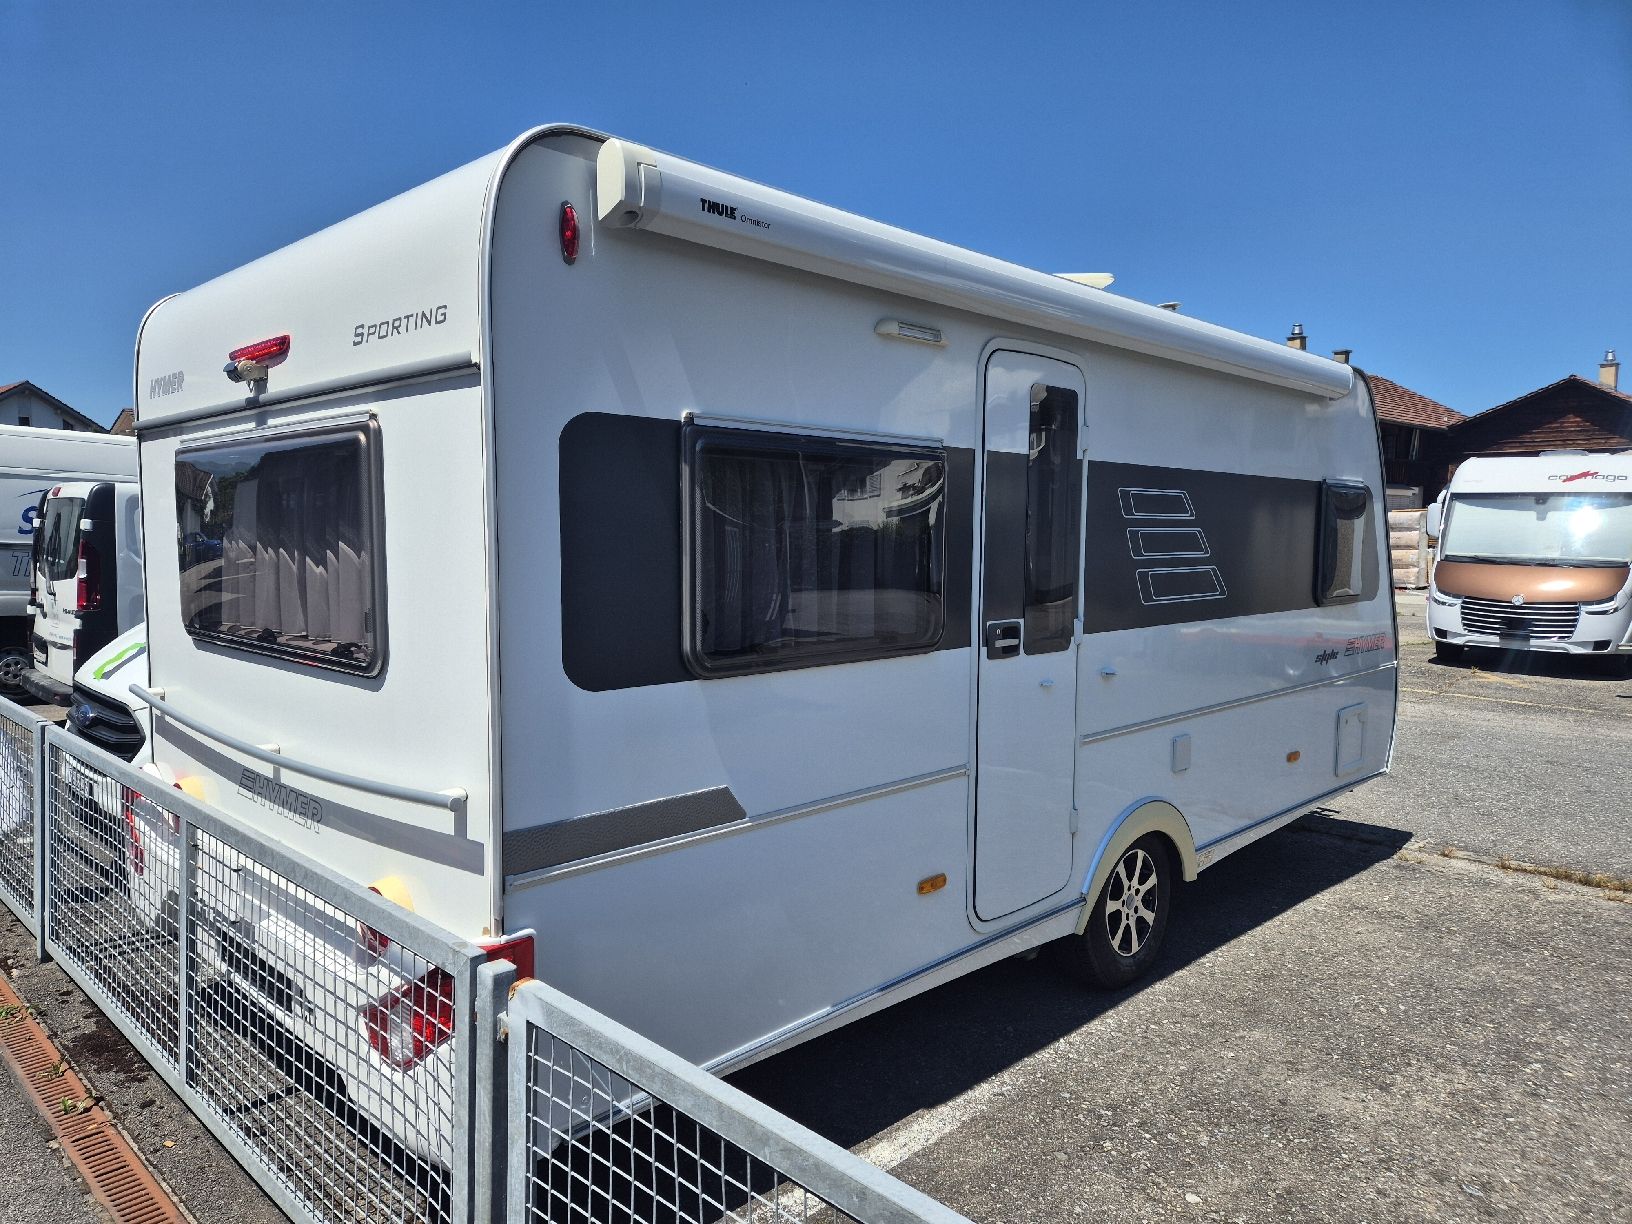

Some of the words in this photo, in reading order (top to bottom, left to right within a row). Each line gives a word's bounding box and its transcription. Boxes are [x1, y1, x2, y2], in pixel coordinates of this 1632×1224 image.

[700, 198, 737, 220] THULE
[149, 370, 185, 400] HYMER
[1548, 471, 1628, 483] cahago
[251, 772, 323, 834] HYMER
